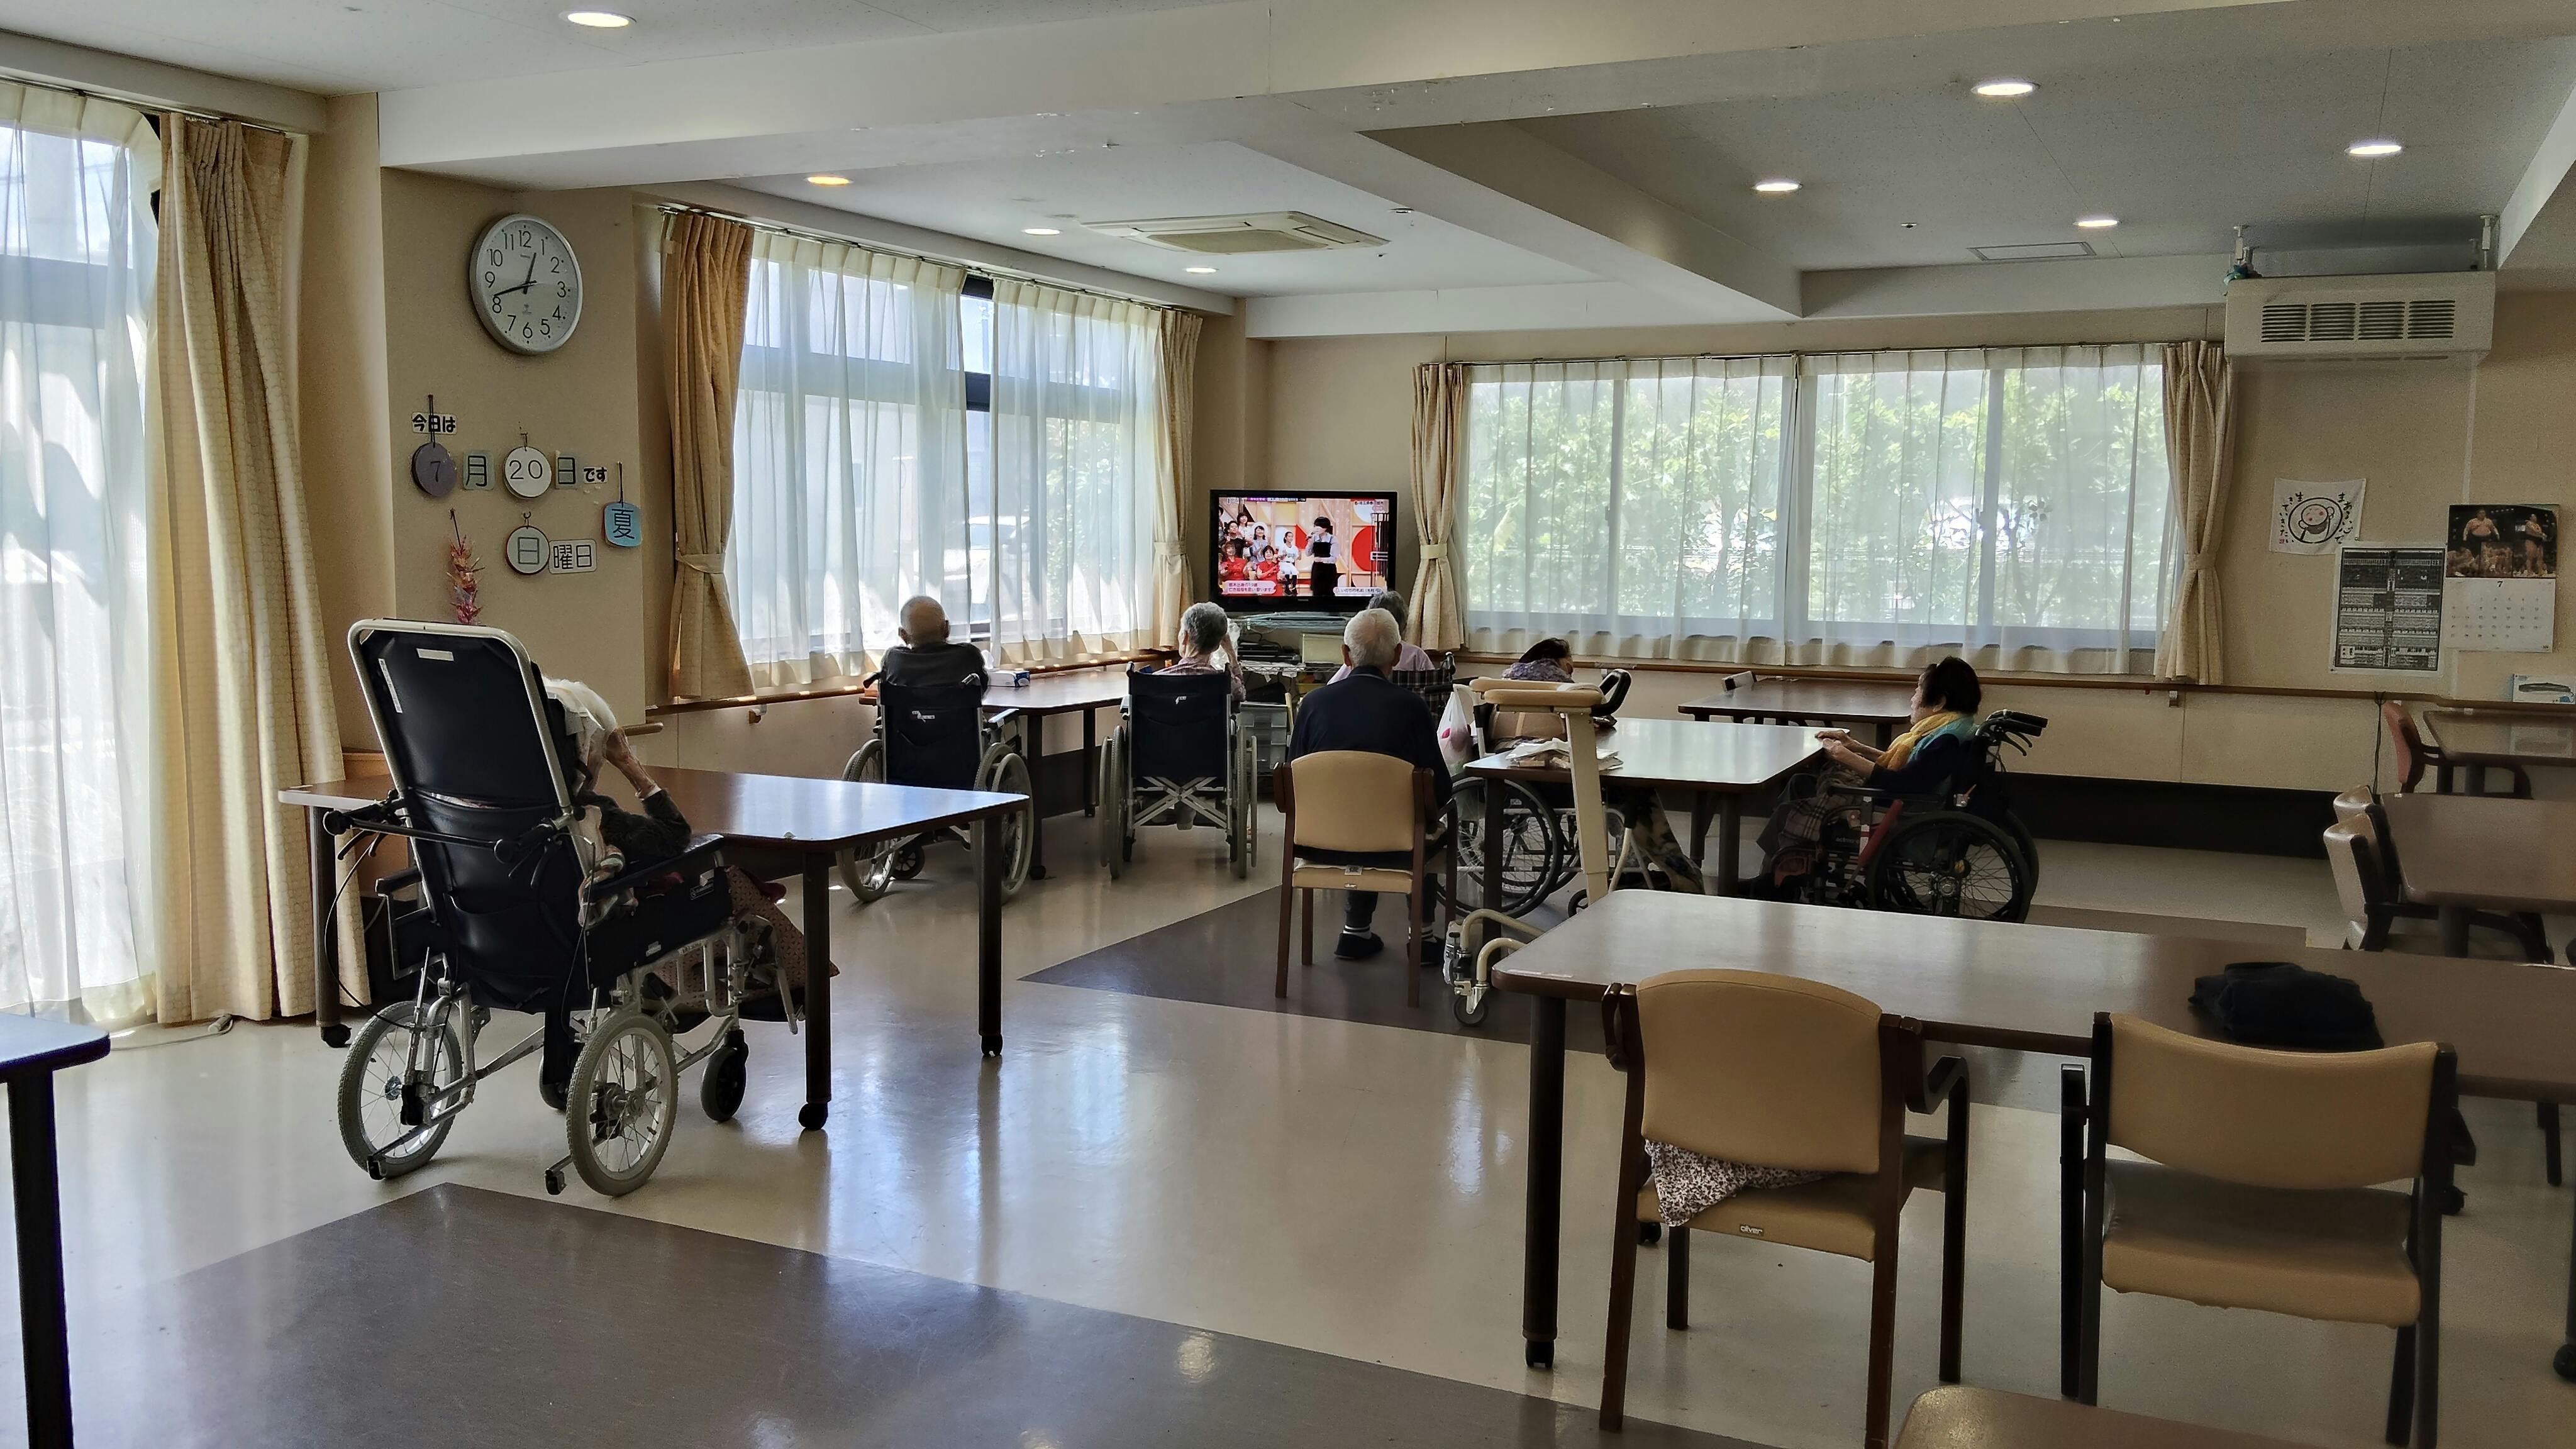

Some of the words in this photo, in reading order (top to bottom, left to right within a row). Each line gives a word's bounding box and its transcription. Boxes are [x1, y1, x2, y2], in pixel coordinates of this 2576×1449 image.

[504, 233, 514, 251] 11
[518, 230, 532, 248] 12
[541, 239, 545, 256] 1
[487, 248, 503, 267] 10
[550, 256, 560, 274] 2
[485, 271, 496, 289] 9
[557, 280, 567, 299] 3
[492, 296, 502, 314] 8
[552, 305, 562, 321] 4
[507, 314, 517, 332] 7
[523, 322, 533, 339] 6
[540, 318, 551, 336] 5
[412, 414, 456, 433] 今日は
[430, 460, 441, 482] 7
[465, 455, 487, 487] 月
[509, 460, 543, 480] 20
[557, 457, 576, 485] 日
[583, 467, 608, 482] です
[611, 508, 635, 540] 夏
[517, 536, 540, 565] 日
[553, 545, 592, 570] 曜日
